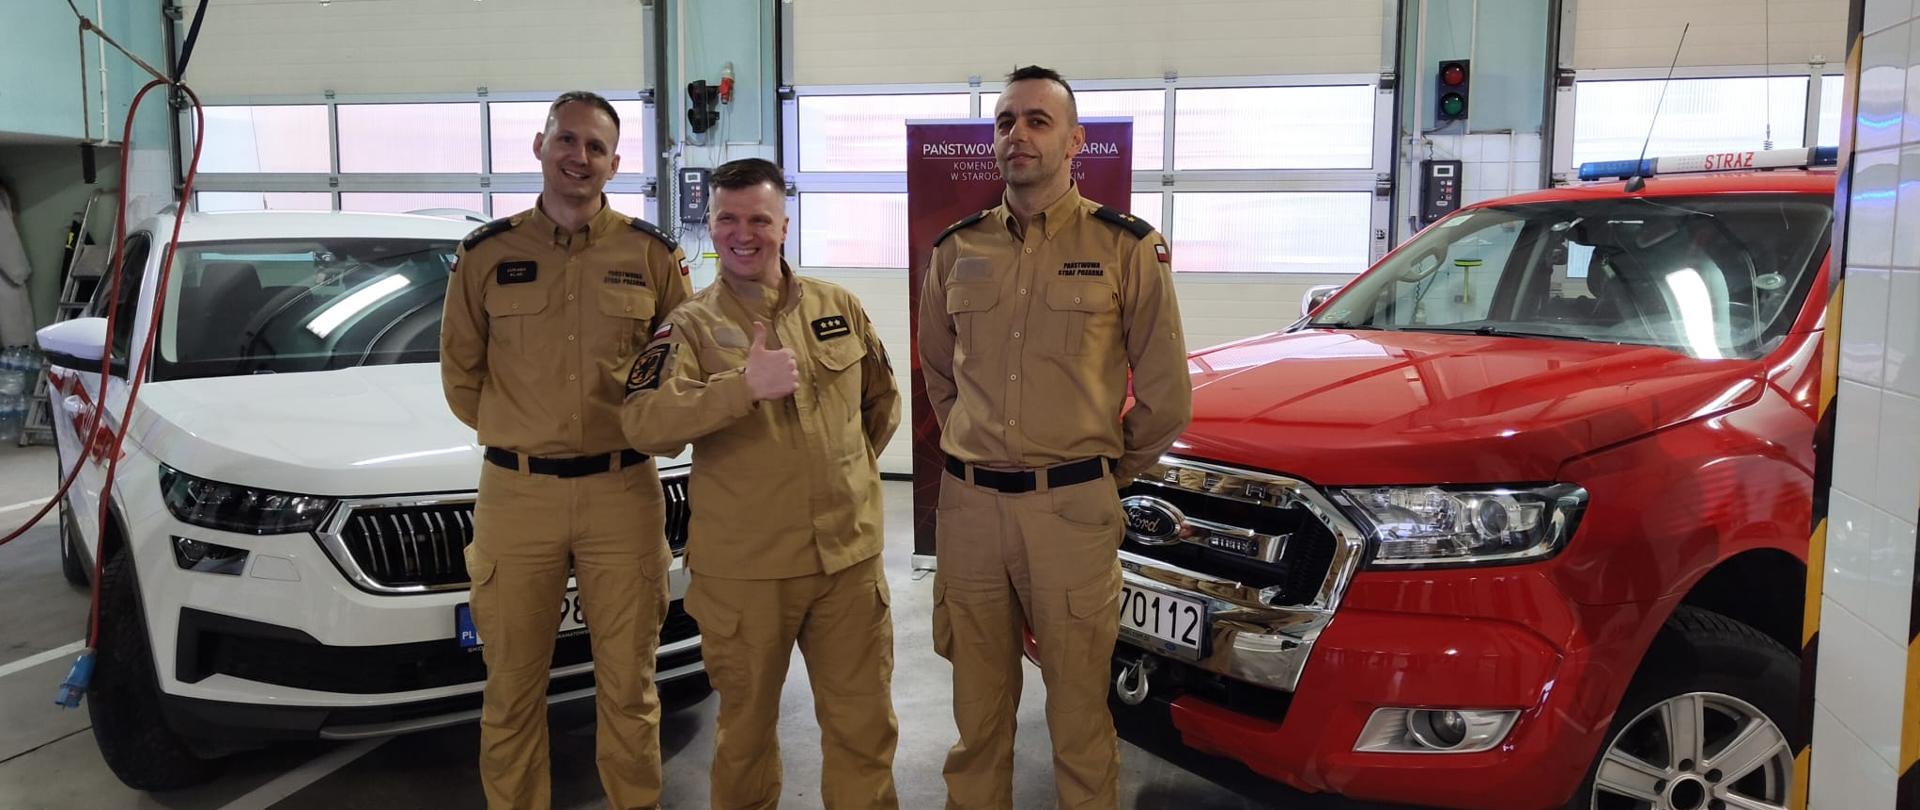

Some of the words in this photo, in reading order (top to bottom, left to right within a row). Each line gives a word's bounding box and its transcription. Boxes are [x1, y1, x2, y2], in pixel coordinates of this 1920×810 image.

[922, 140, 996, 156] PAŃSTWOW
[1078, 142, 1119, 155] ARNA
[950, 172, 959, 181] W
[962, 172, 1001, 181] STAROG
[1120, 586, 1199, 646] 70112
[462, 631, 475, 640] PL
